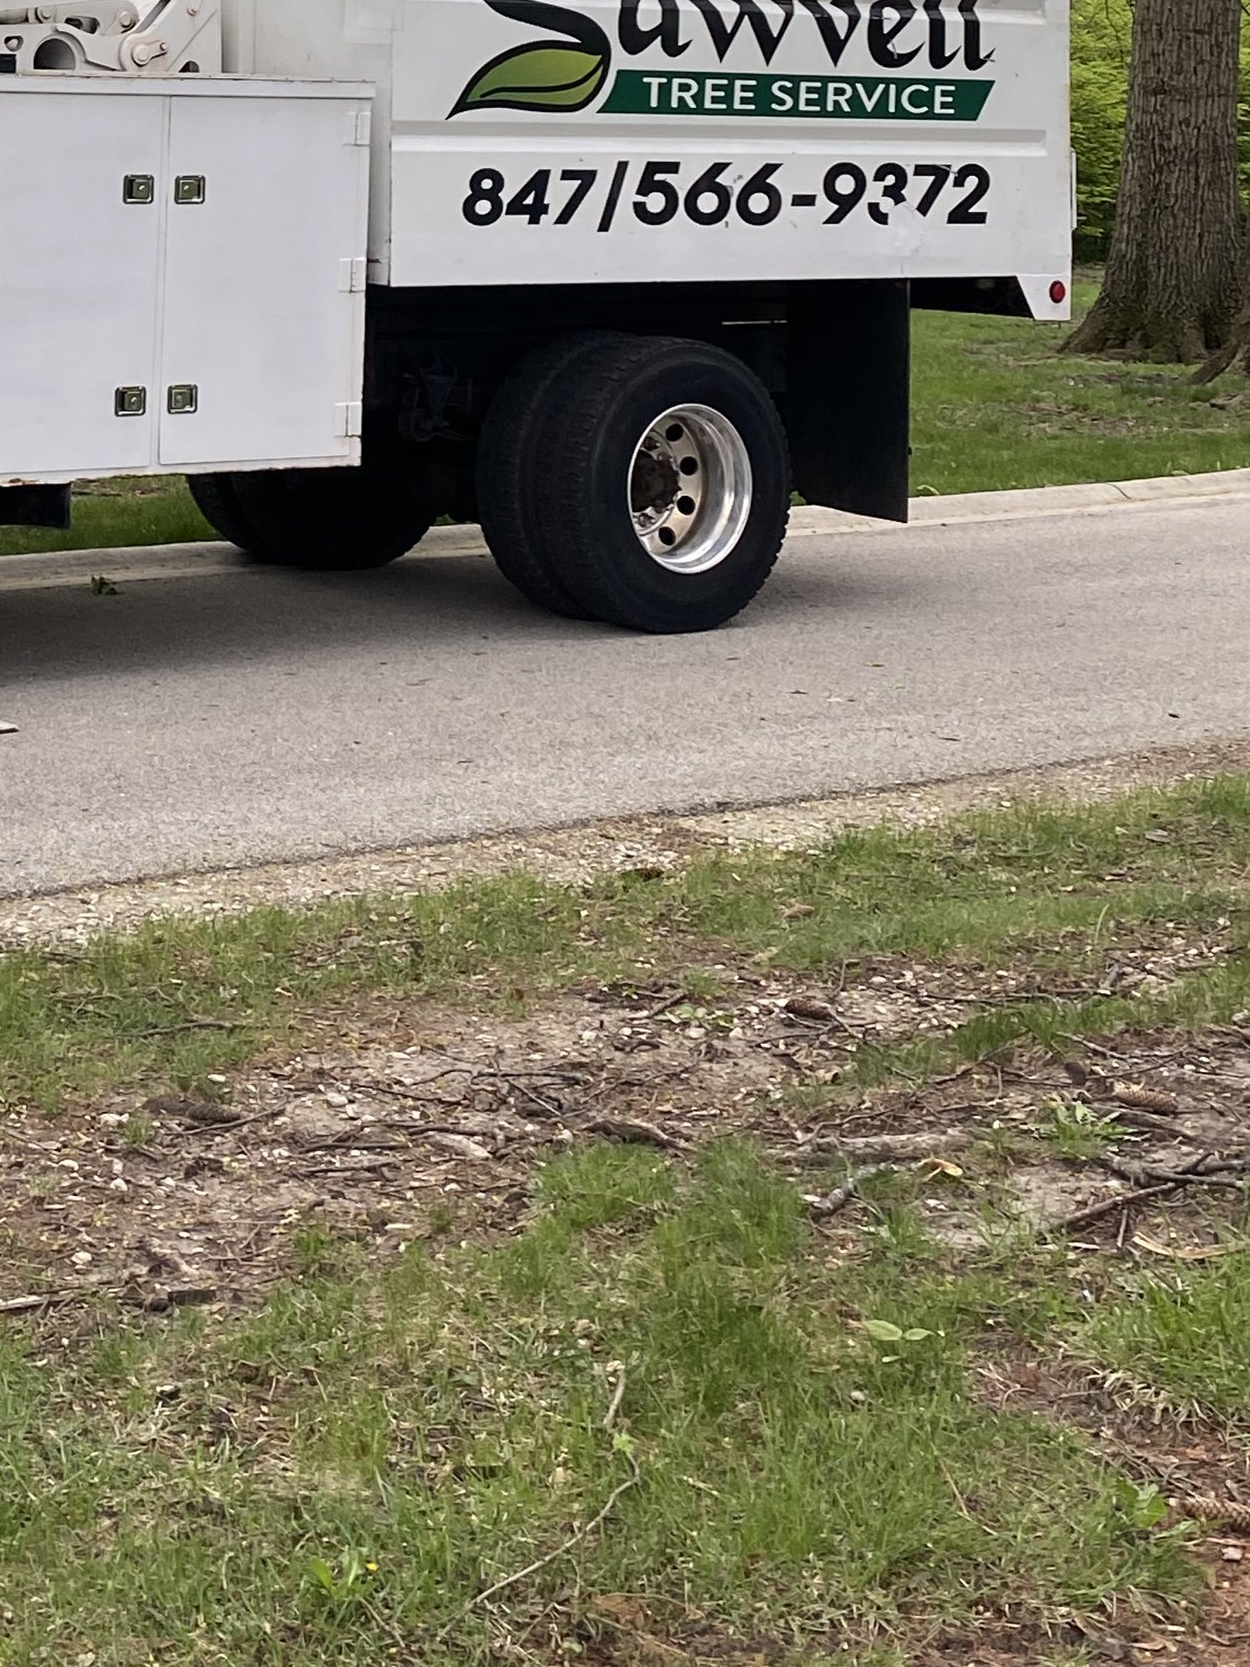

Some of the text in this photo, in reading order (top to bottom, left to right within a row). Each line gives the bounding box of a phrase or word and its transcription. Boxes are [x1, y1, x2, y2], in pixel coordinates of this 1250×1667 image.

[642, 76, 957, 115] TREE SERVICE
[461, 160, 991, 233] 847/566-9372
